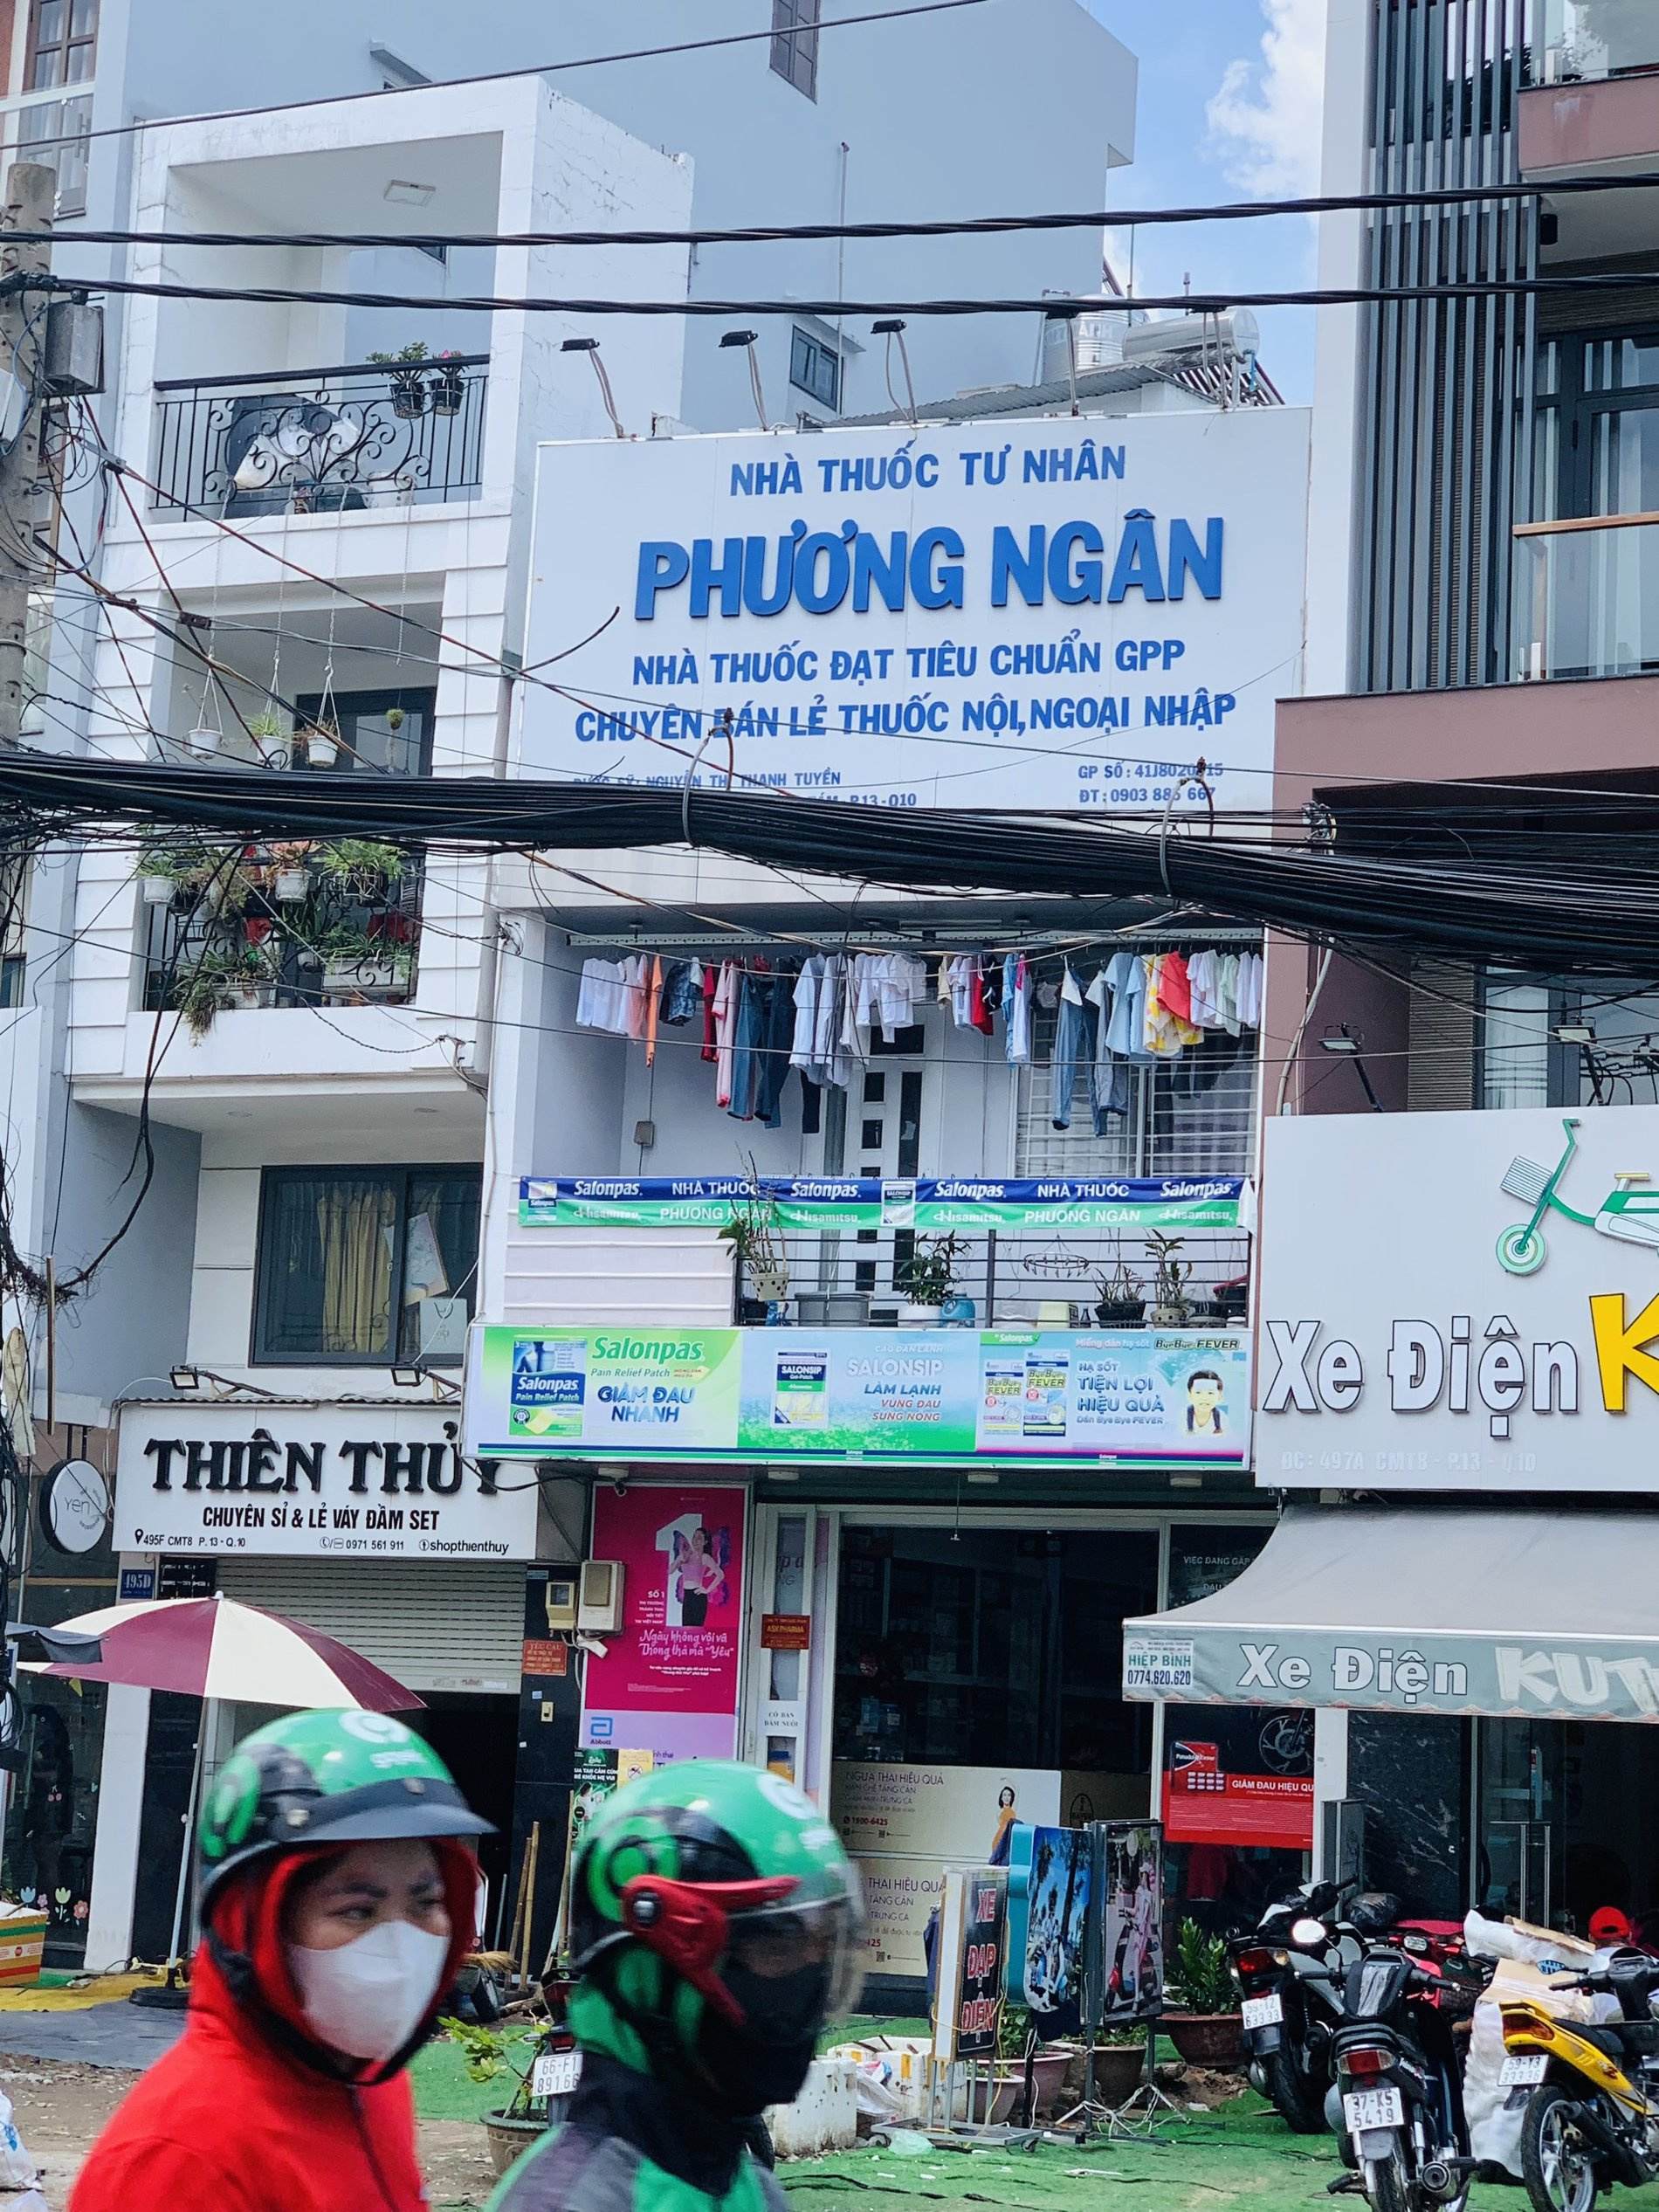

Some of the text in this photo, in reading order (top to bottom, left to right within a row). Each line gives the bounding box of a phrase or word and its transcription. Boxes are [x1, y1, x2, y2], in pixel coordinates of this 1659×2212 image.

[730, 438, 1126, 496] NHÀ THUỐC TƯ NHÂN
[635, 509, 1223, 621] PHƯƠNG NGÂN
[633, 628, 1186, 686] NHÀ THUỐC ĐẠT TIÊU CHUẨN GPP
[575, 703, 702, 741] CHUYÊN
[789, 694, 826, 736] LẺ
[838, 693, 950, 735] THUỐC
[1145, 686, 1236, 732] NHẬP
[710, 775, 732, 789] TH
[795, 768, 841, 785] TUYỀN
[1078, 765, 1098, 779] GP
[1111, 788, 1147, 802] 0903
[575, 1181, 641, 1198] Salonpas
[671, 1181, 705, 1195] NHÀ
[790, 1182, 858, 1200] Salonpas
[934, 1182, 1004, 1200] Salonpas
[1036, 1183, 1070, 1197] NHÀ
[1074, 1182, 1130, 1197] THUỐC
[1160, 1181, 1231, 1199] Salonpas
[789, 1209, 859, 1223] Hisamitsu
[933, 1209, 1003, 1223] Hisamitsu
[1159, 1209, 1230, 1220] Hisamitsu
[999, 1333, 1034, 1343] Salonpas
[592, 1336, 704, 1365] Salonpas
[590, 1368, 611, 1377] Pain
[615, 1368, 643, 1378] Relief
[644, 1368, 671, 1378] Patch
[781, 1365, 823, 1375] SALONSIP
[846, 1357, 944, 1377] SALONSIP
[1078, 1362, 1094, 1373] HẠ
[517, 1376, 580, 1393] Salonpas
[1077, 1375, 1153, 1394] TIỆN LỢI
[1262, 1320, 1365, 1413] Xe
[1387, 1315, 1579, 1439] Điện
[534, 1393, 558, 1402] Relief
[559, 1393, 580, 1402] Patch
[598, 1382, 695, 1404] GIẢM ĐAU
[611, 1405, 679, 1423] NHANH
[1077, 1395, 1119, 1415] HIỆU
[143, 1427, 327, 1494] THIÊN
[1319, 1451, 1366, 1471] 497A
[1375, 1451, 1429, 1471] CMT8
[203, 1501, 440, 1530] CHUYÊN SỈ & LẺ VÁY ĐẦM SET
[143, 1534, 165, 1546] 495F
[168, 1535, 193, 1547] CMT8
[346, 1540, 368, 1550] 0971
[371, 1540, 387, 1550] 561
[389, 1540, 404, 1551] 911
[430, 1540, 510, 1555] shopthienthuy
[648, 1589, 660, 1598] SỐ
[639, 1629, 670, 1647] Ngày
[671, 1630, 700, 1648] không
[701, 1631, 715, 1644] vội
[638, 1643, 671, 1661] Thong
[1128, 1650, 1192, 1669] HIỆP BÌNH
[1127, 1669, 1192, 1685] 0774.620.620
[1238, 1643, 1311, 1689] Xe
[1332, 1646, 1468, 1704] Điện
[1232, 1779, 1313, 1793] GIẢM ĐAU HIỆU QU
[868, 1877, 891, 1890] THAI
[976, 1888, 997, 1924] XE
[542, 2056, 576, 2075] 66-F1
